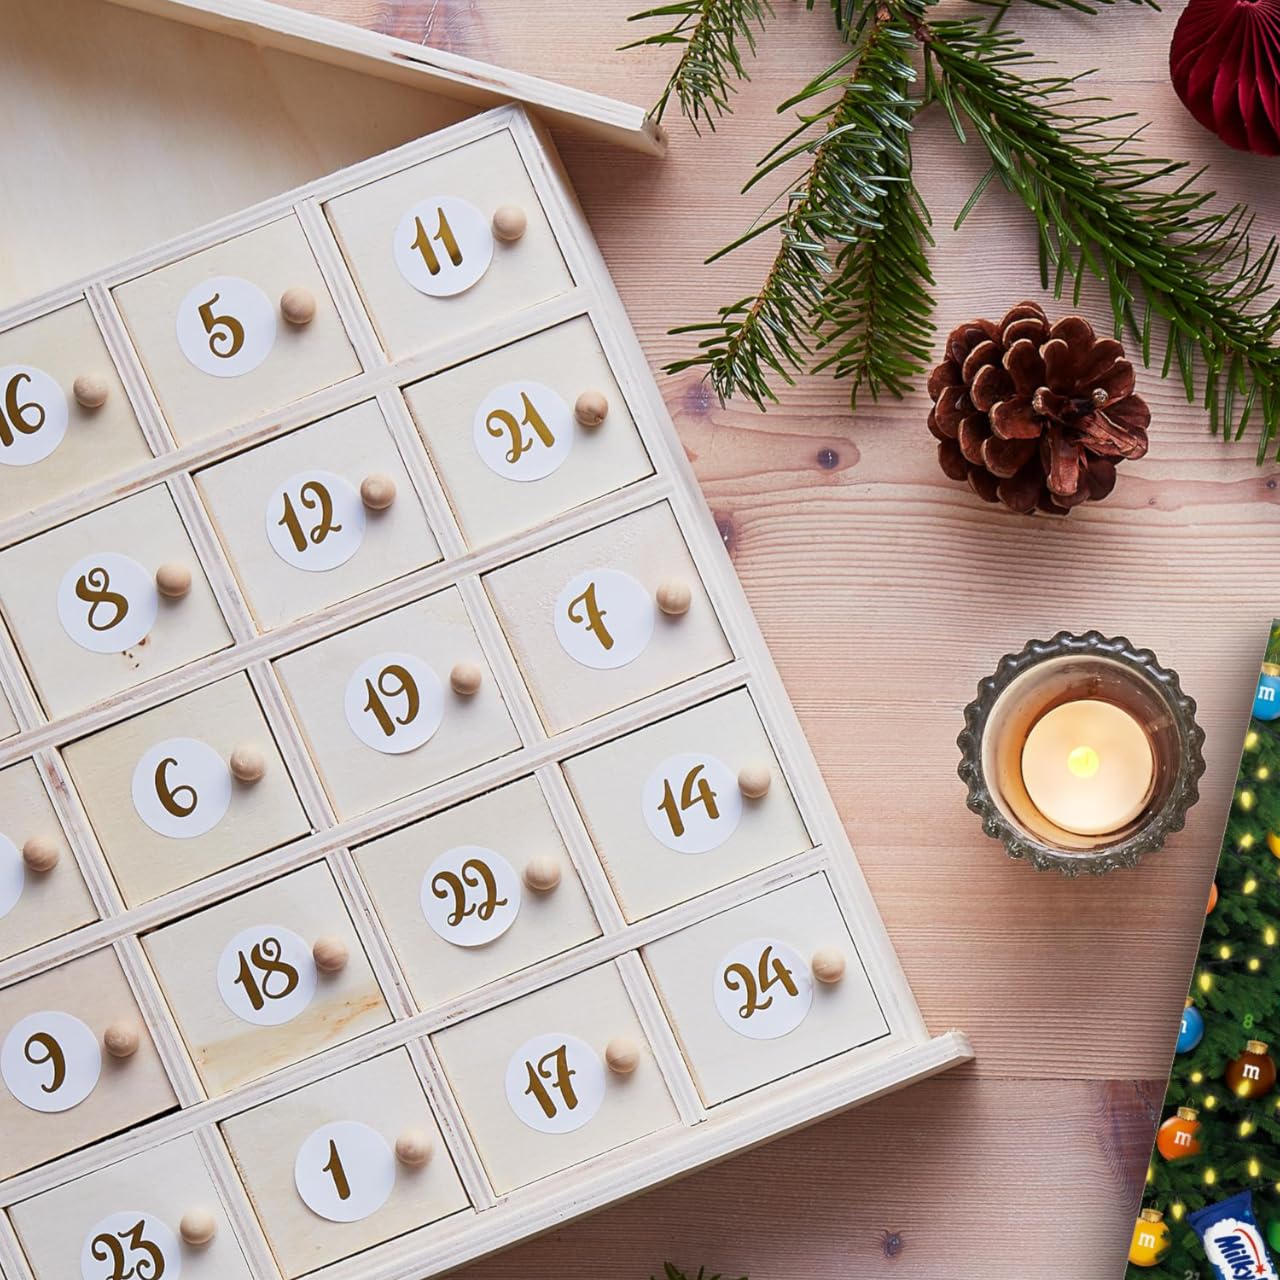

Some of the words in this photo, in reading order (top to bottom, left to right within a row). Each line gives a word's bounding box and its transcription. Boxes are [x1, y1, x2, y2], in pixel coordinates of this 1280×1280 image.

[411, 208, 463, 276] 11
[198, 293, 245, 359] 5
[485, 391, 556, 464] 21
[278, 480, 343, 553] 12
[75, 567, 129, 632] 8
[567, 582, 615, 651] 7
[363, 664, 420, 737] 19
[1257, 685, 1276, 702] m
[154, 757, 198, 818] 6
[657, 764, 720, 838] 14
[431, 858, 508, 927] 22
[234, 937, 300, 1011] 18
[723, 945, 799, 1019] 24
[1243, 1014, 1254, 1029] 8
[24, 1032, 67, 1094] 9
[525, 1044, 579, 1119] 17
[1242, 1063, 1260, 1080] m
[322, 1139, 351, 1200] 1
[1173, 1130, 1192, 1147] m
[1137, 1232, 1156, 1249] m
